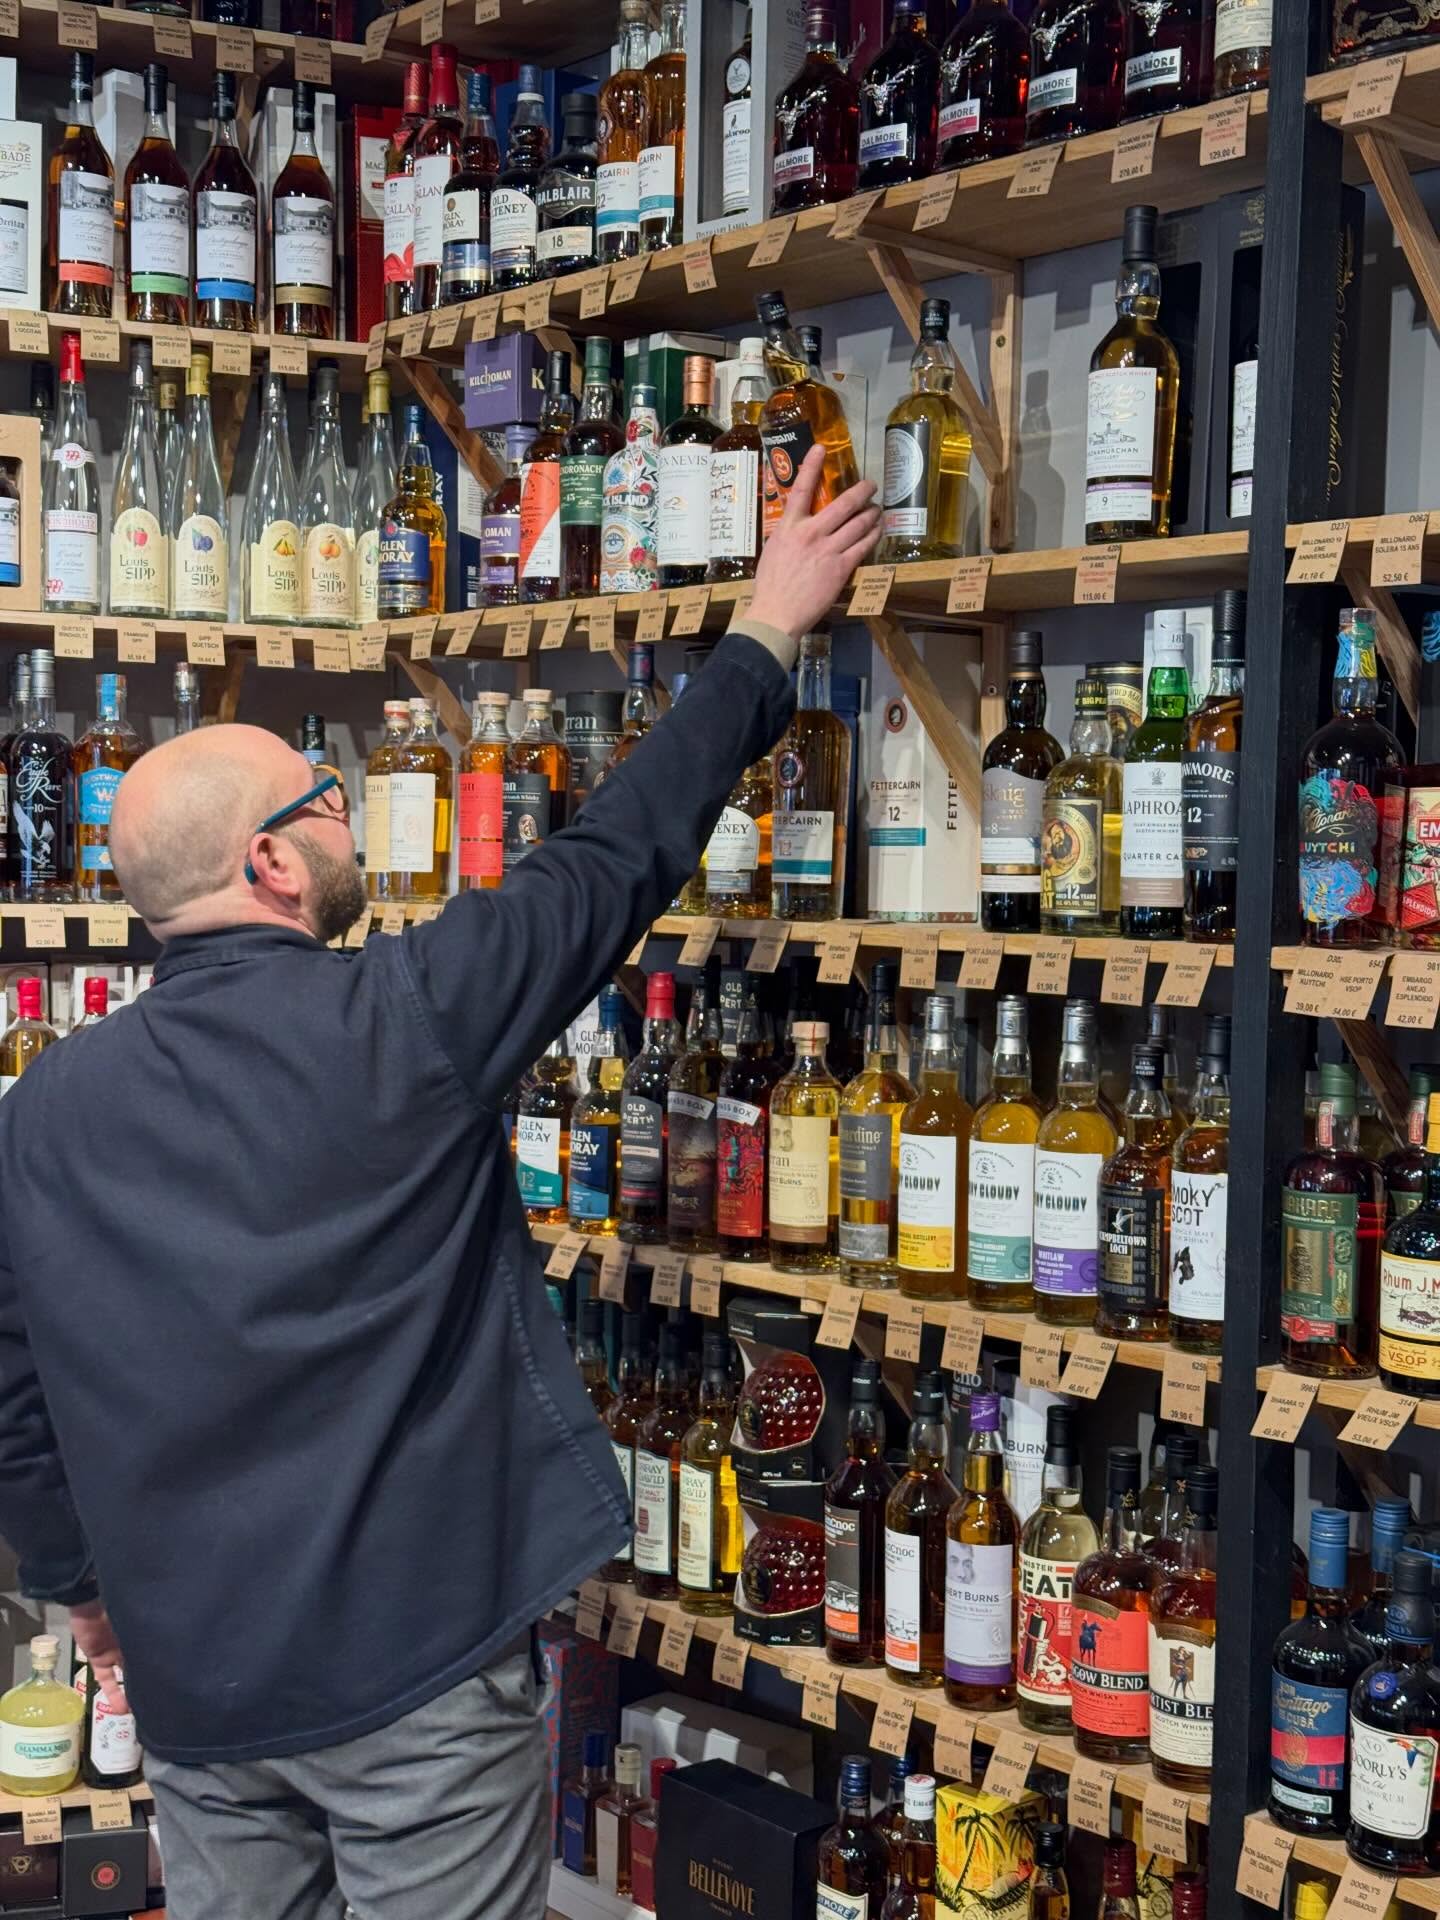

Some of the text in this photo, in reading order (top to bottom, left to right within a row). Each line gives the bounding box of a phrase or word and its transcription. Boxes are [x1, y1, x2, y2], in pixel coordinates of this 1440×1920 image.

[1128, 55, 1176, 75] DALMORE
[1031, 77, 1072, 96] DALMORE
[862, 131, 902, 147] DALMORE
[775, 154, 810, 170] DALMORE
[552, 235, 563, 247] 18
[1102, 495, 1109, 506] 9
[1242, 490, 1249, 503] 9
[125, 567, 157, 580] SIPP
[191, 573, 221, 586] SIPP
[1383, 572, 1409, 582] 52,50 €
[318, 580, 347, 594] SIPP
[871, 780, 921, 791] FETTERCAIRN
[34, 803, 44, 813] 10
[889, 806, 901, 821] 12
[1187, 807, 1202, 823] 12
[991, 822, 998, 834] 8
[1066, 884, 1080, 899] 12
[725, 982, 742, 993] OLD
[1313, 1003, 1320, 1012] €
[1417, 1015, 1424, 1024] €
[627, 1103, 646, 1113] OLD
[570, 1142, 600, 1156] ORAY
[1172, 1206, 1204, 1227] SCOT
[1110, 1243, 1128, 1255] LOCH
[1383, 1268, 1412, 1289] Rhum
[965, 1591, 1000, 1603] BURNS
[1101, 1672, 1144, 1691] BLEND
